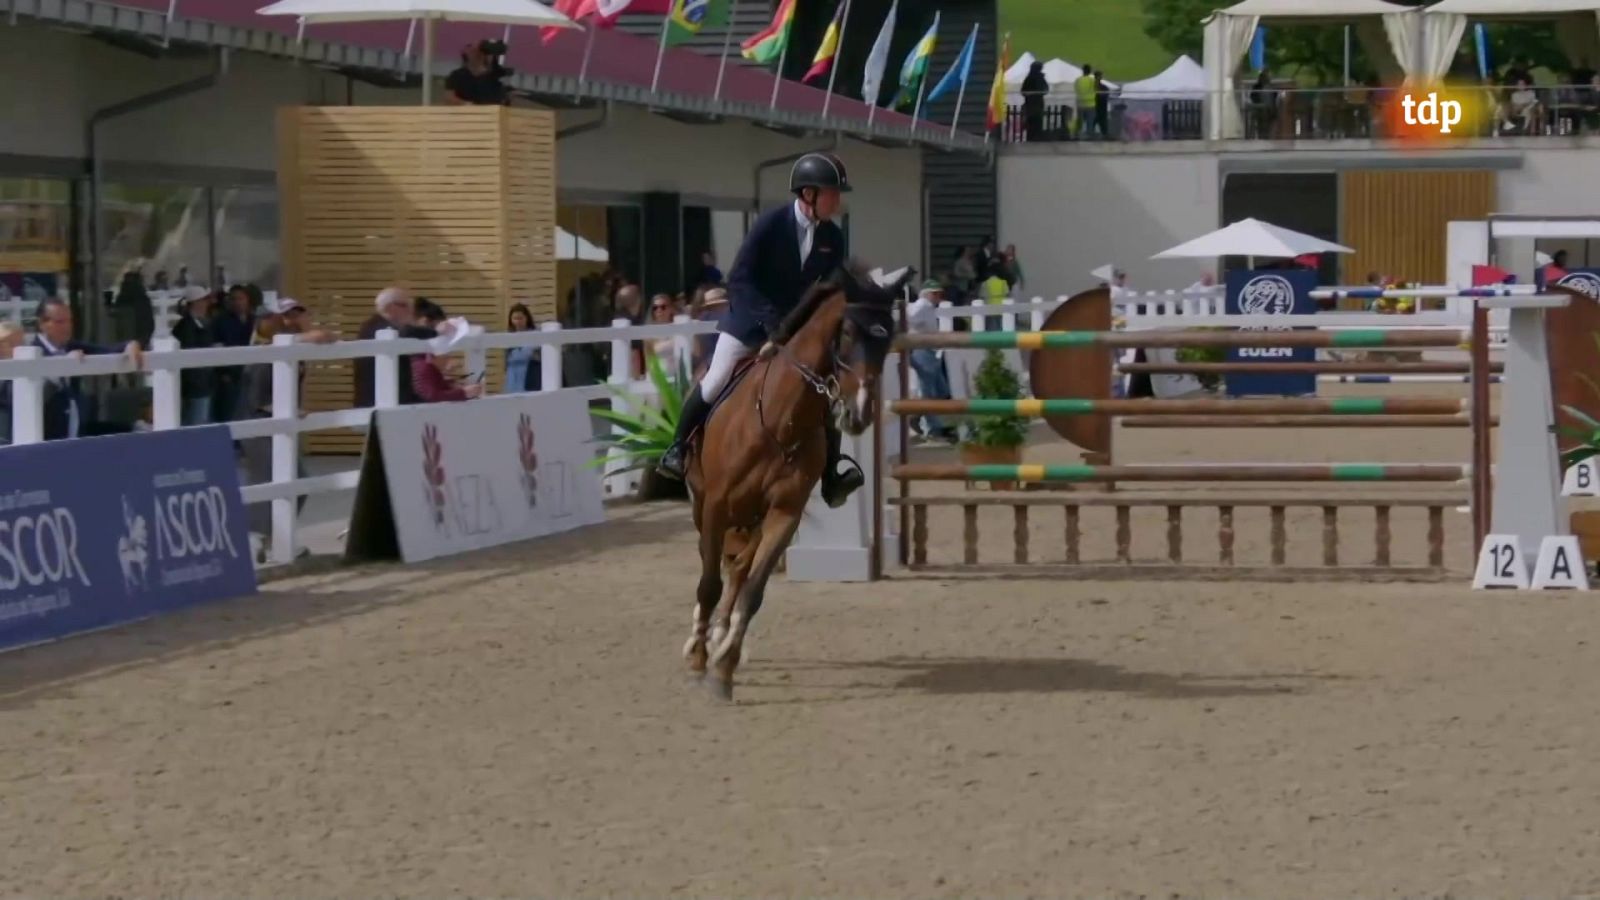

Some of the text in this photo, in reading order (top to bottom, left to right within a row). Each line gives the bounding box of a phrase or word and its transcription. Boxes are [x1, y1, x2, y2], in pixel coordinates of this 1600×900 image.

[1577, 464, 1590, 488] B
[155, 486, 238, 560] ASCOR
[1490, 544, 1515, 578] 12
[1550, 546, 1572, 579] A
